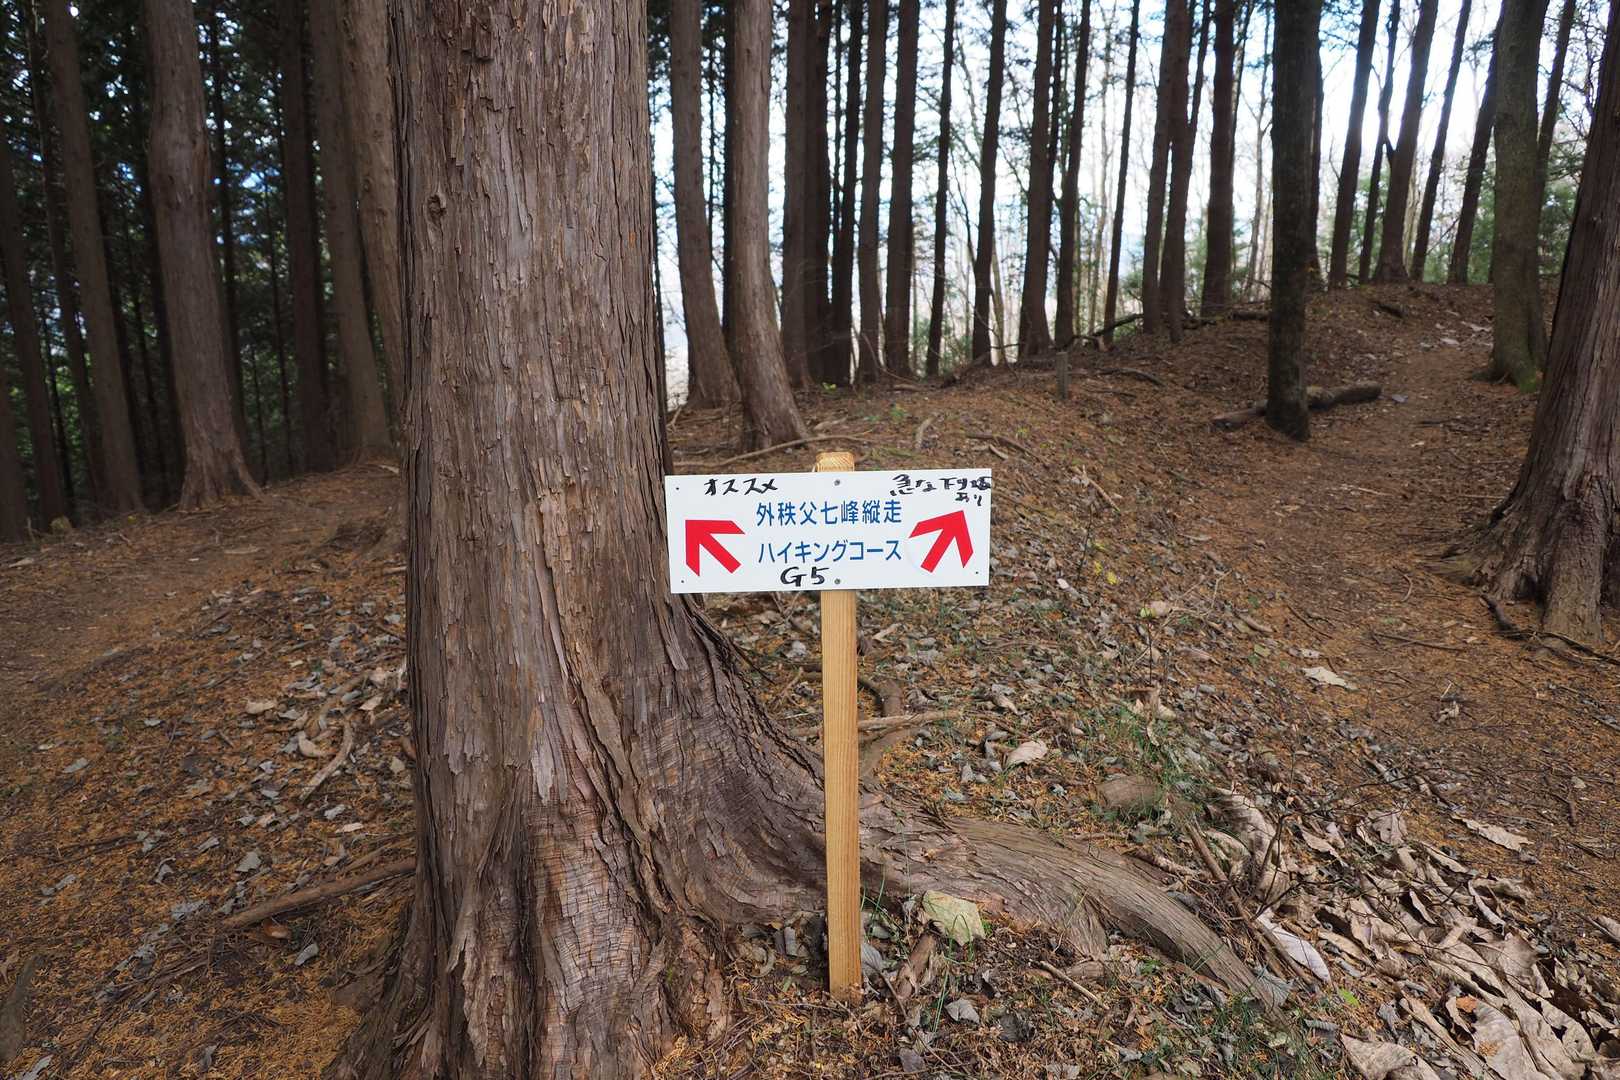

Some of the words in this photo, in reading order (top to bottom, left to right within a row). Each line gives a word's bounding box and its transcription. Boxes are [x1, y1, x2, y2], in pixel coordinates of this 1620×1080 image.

[704, 478, 778, 496] オススメ
[756, 500, 901, 526] 外秩父七峰縦走
[758, 539, 902, 564] ハイキングコース
